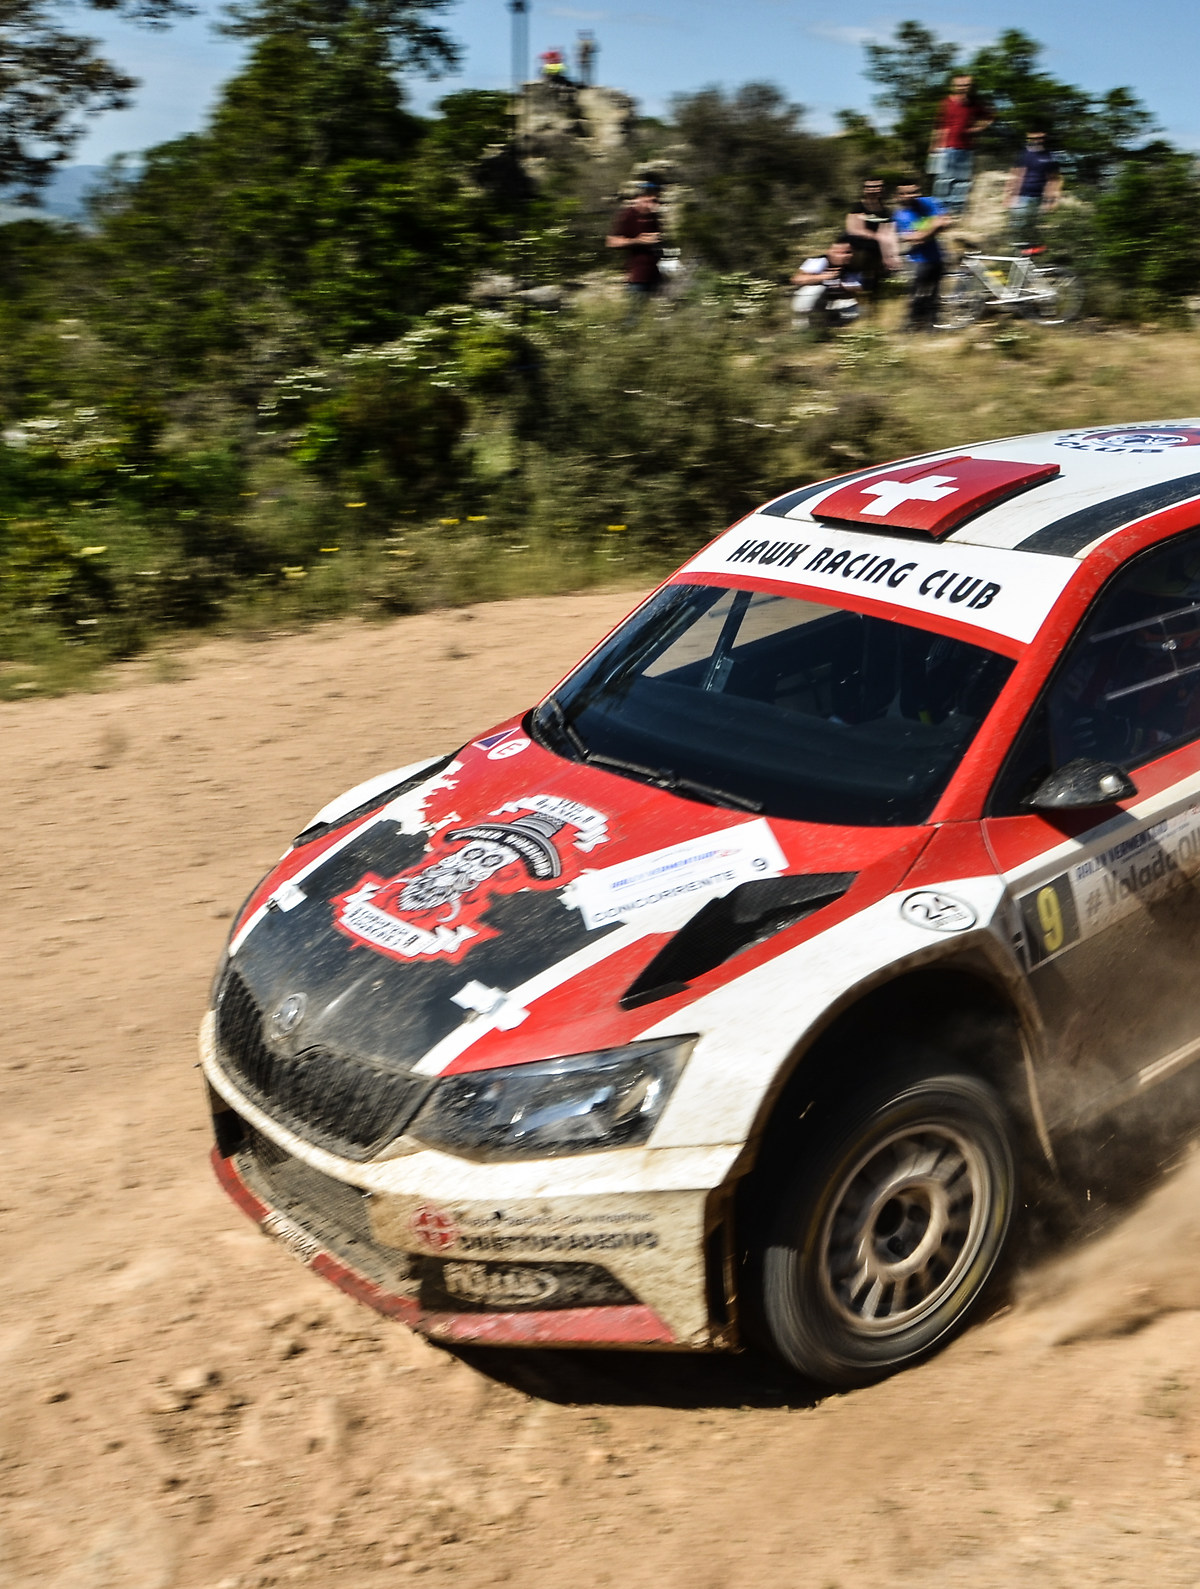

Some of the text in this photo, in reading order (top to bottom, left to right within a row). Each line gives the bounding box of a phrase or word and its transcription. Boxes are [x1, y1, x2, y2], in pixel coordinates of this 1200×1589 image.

[726, 539, 1002, 609] HAWK RACING CLUB
[751, 857, 769, 872] 9
[911, 896, 957, 920] 24
[1036, 886, 1064, 953] 9
